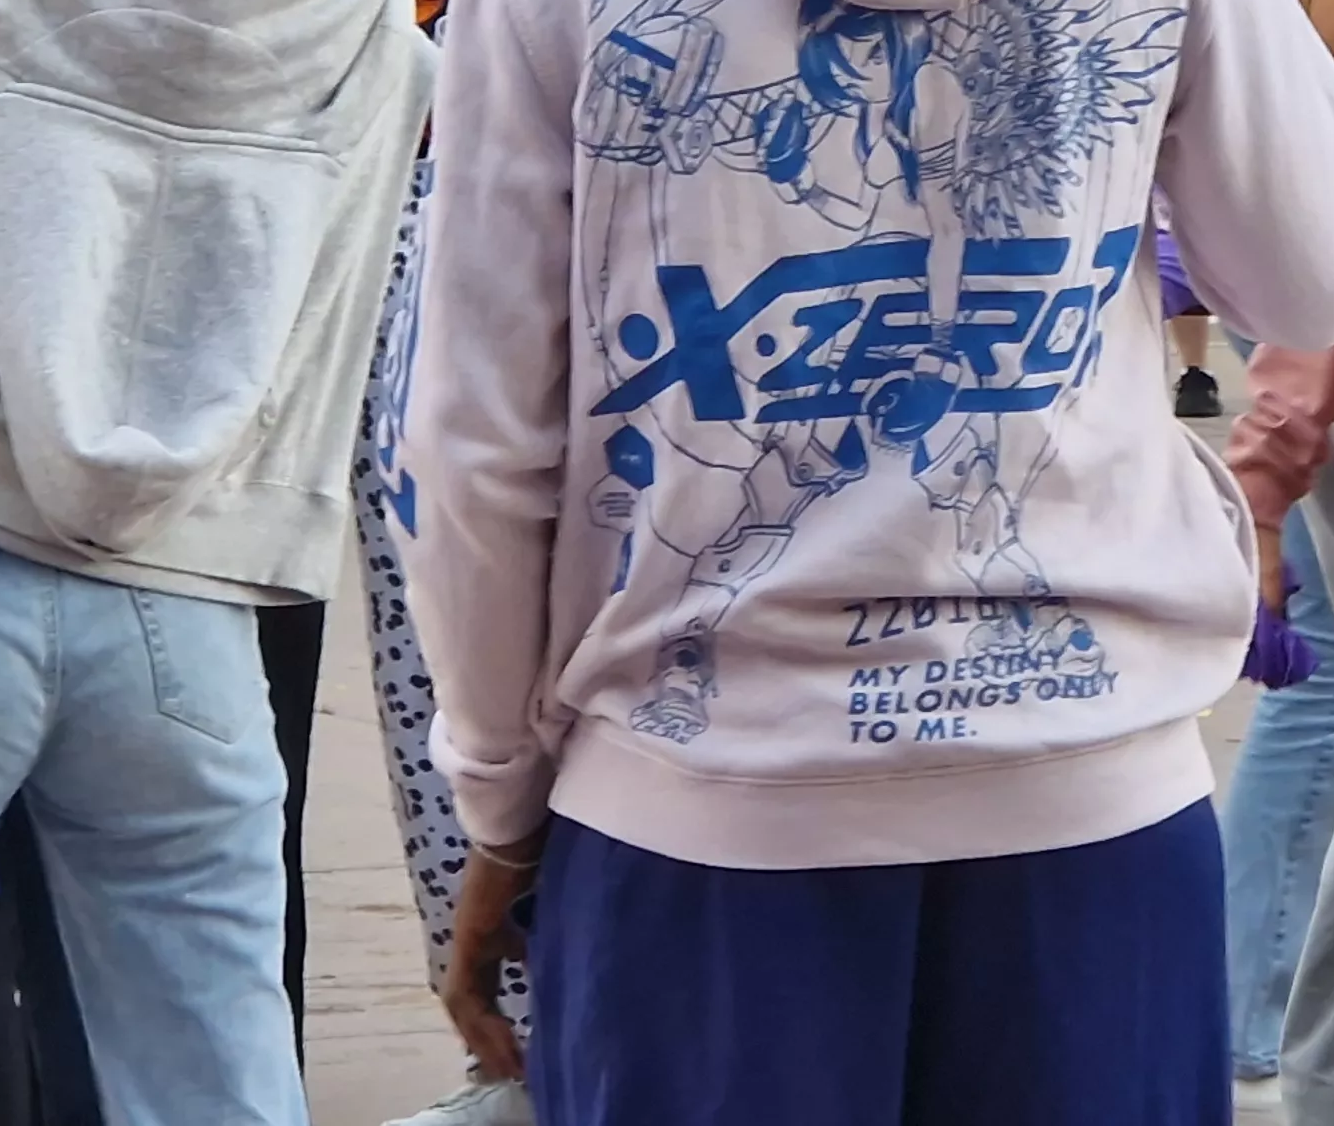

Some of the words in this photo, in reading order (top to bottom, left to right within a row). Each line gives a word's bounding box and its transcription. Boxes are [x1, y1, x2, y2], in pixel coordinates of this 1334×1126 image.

[848, 664, 910, 689] MY
[924, 648, 1063, 685] DESTINY
[847, 681, 1021, 716] BELONGS
[1036, 671, 1119, 702] ONLY
[849, 720, 899, 744] TO
[913, 716, 979, 742] ME.
